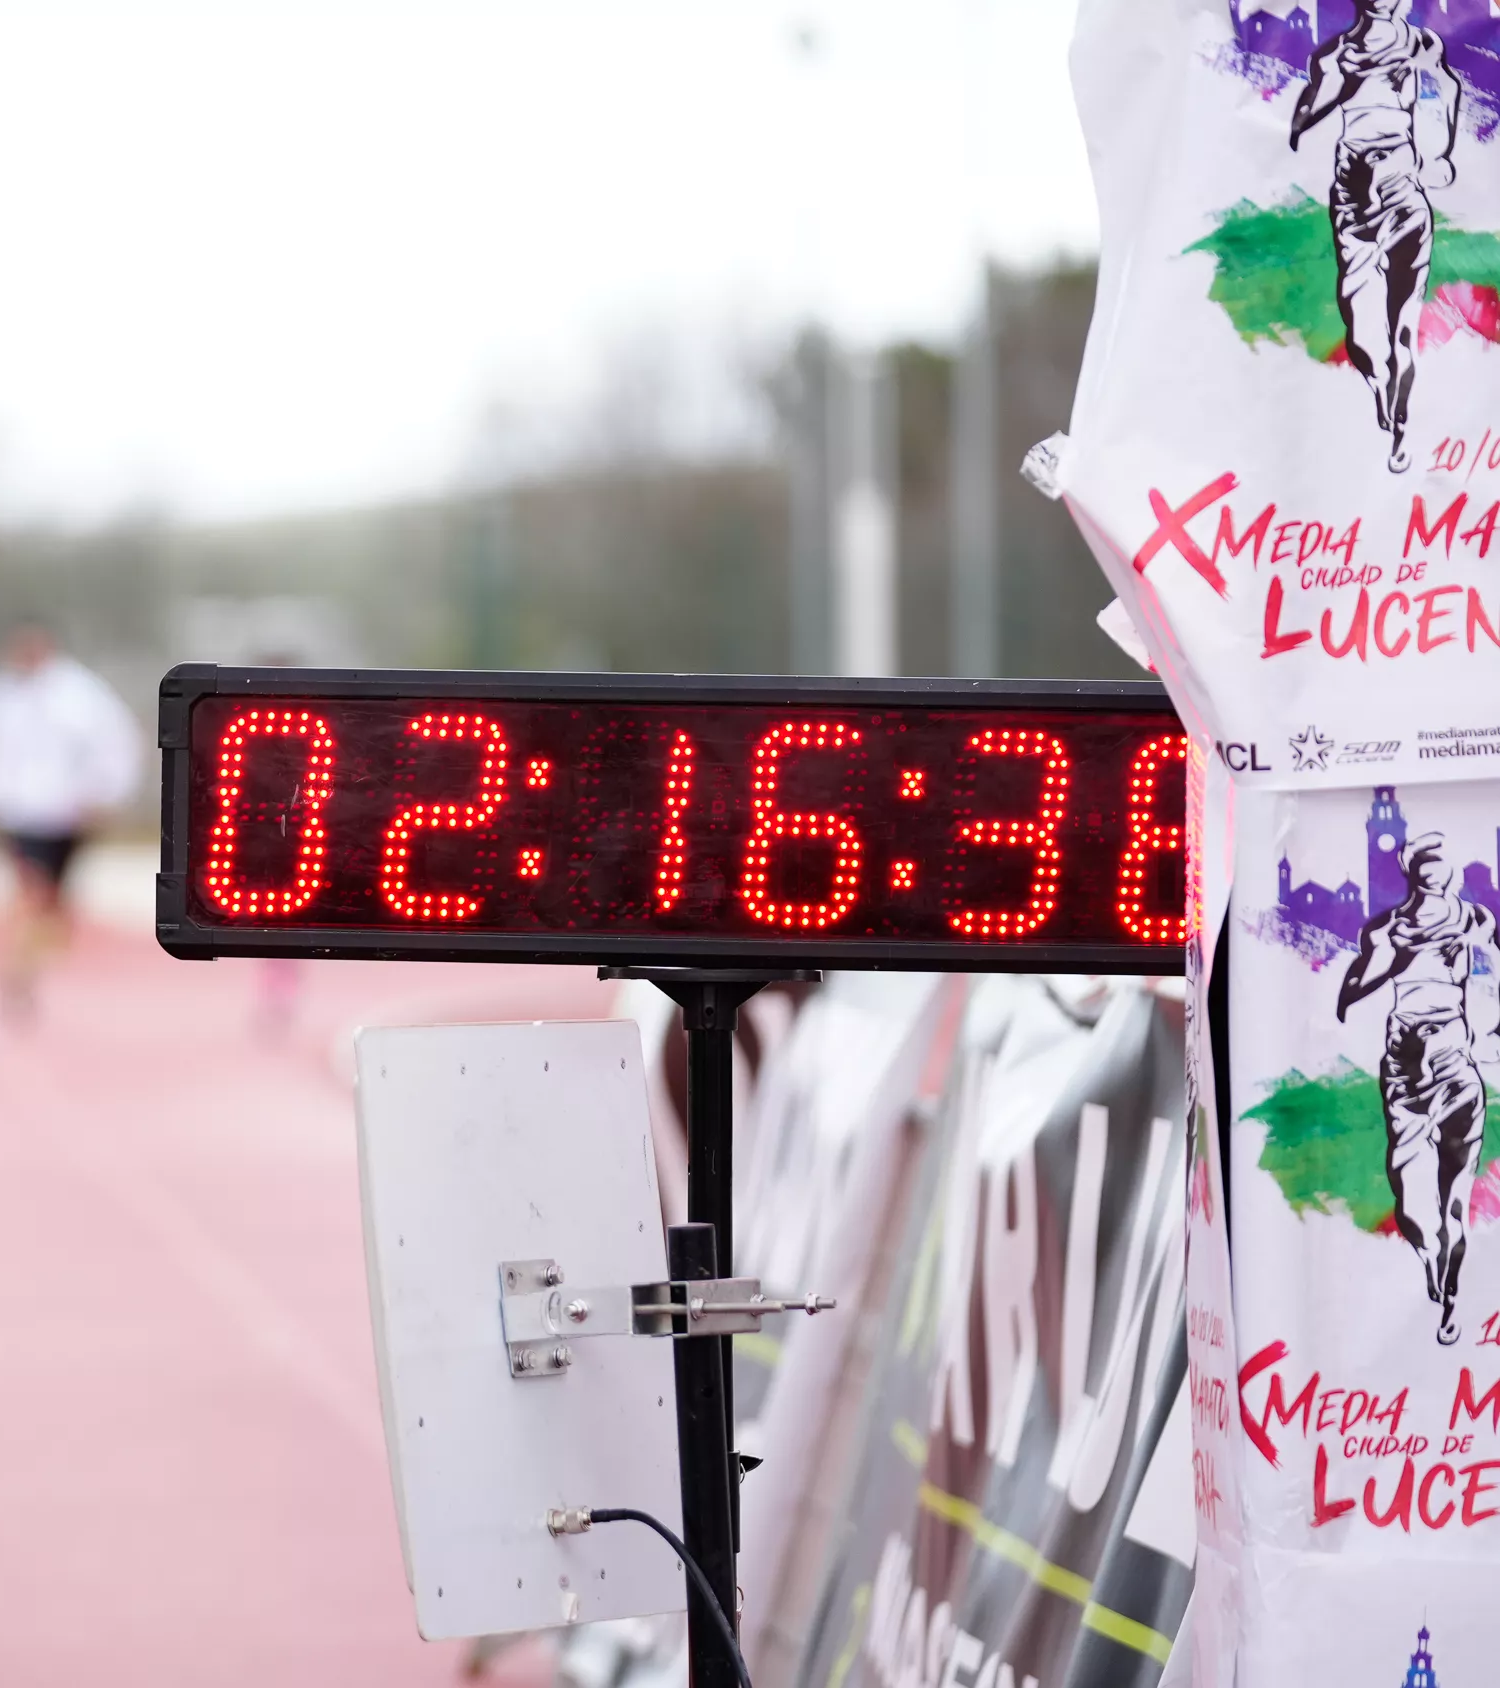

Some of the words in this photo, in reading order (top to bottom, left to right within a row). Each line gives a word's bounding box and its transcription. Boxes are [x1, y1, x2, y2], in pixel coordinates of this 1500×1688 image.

[1301, 562, 1383, 590] CIUDAD
[1395, 561, 1428, 584] DE
[1216, 740, 1271, 772] CL
[1476, 1311, 1500, 1346] 1
[1344, 1433, 1429, 1459] CIUDAD
[1441, 1434, 1474, 1456] DE
